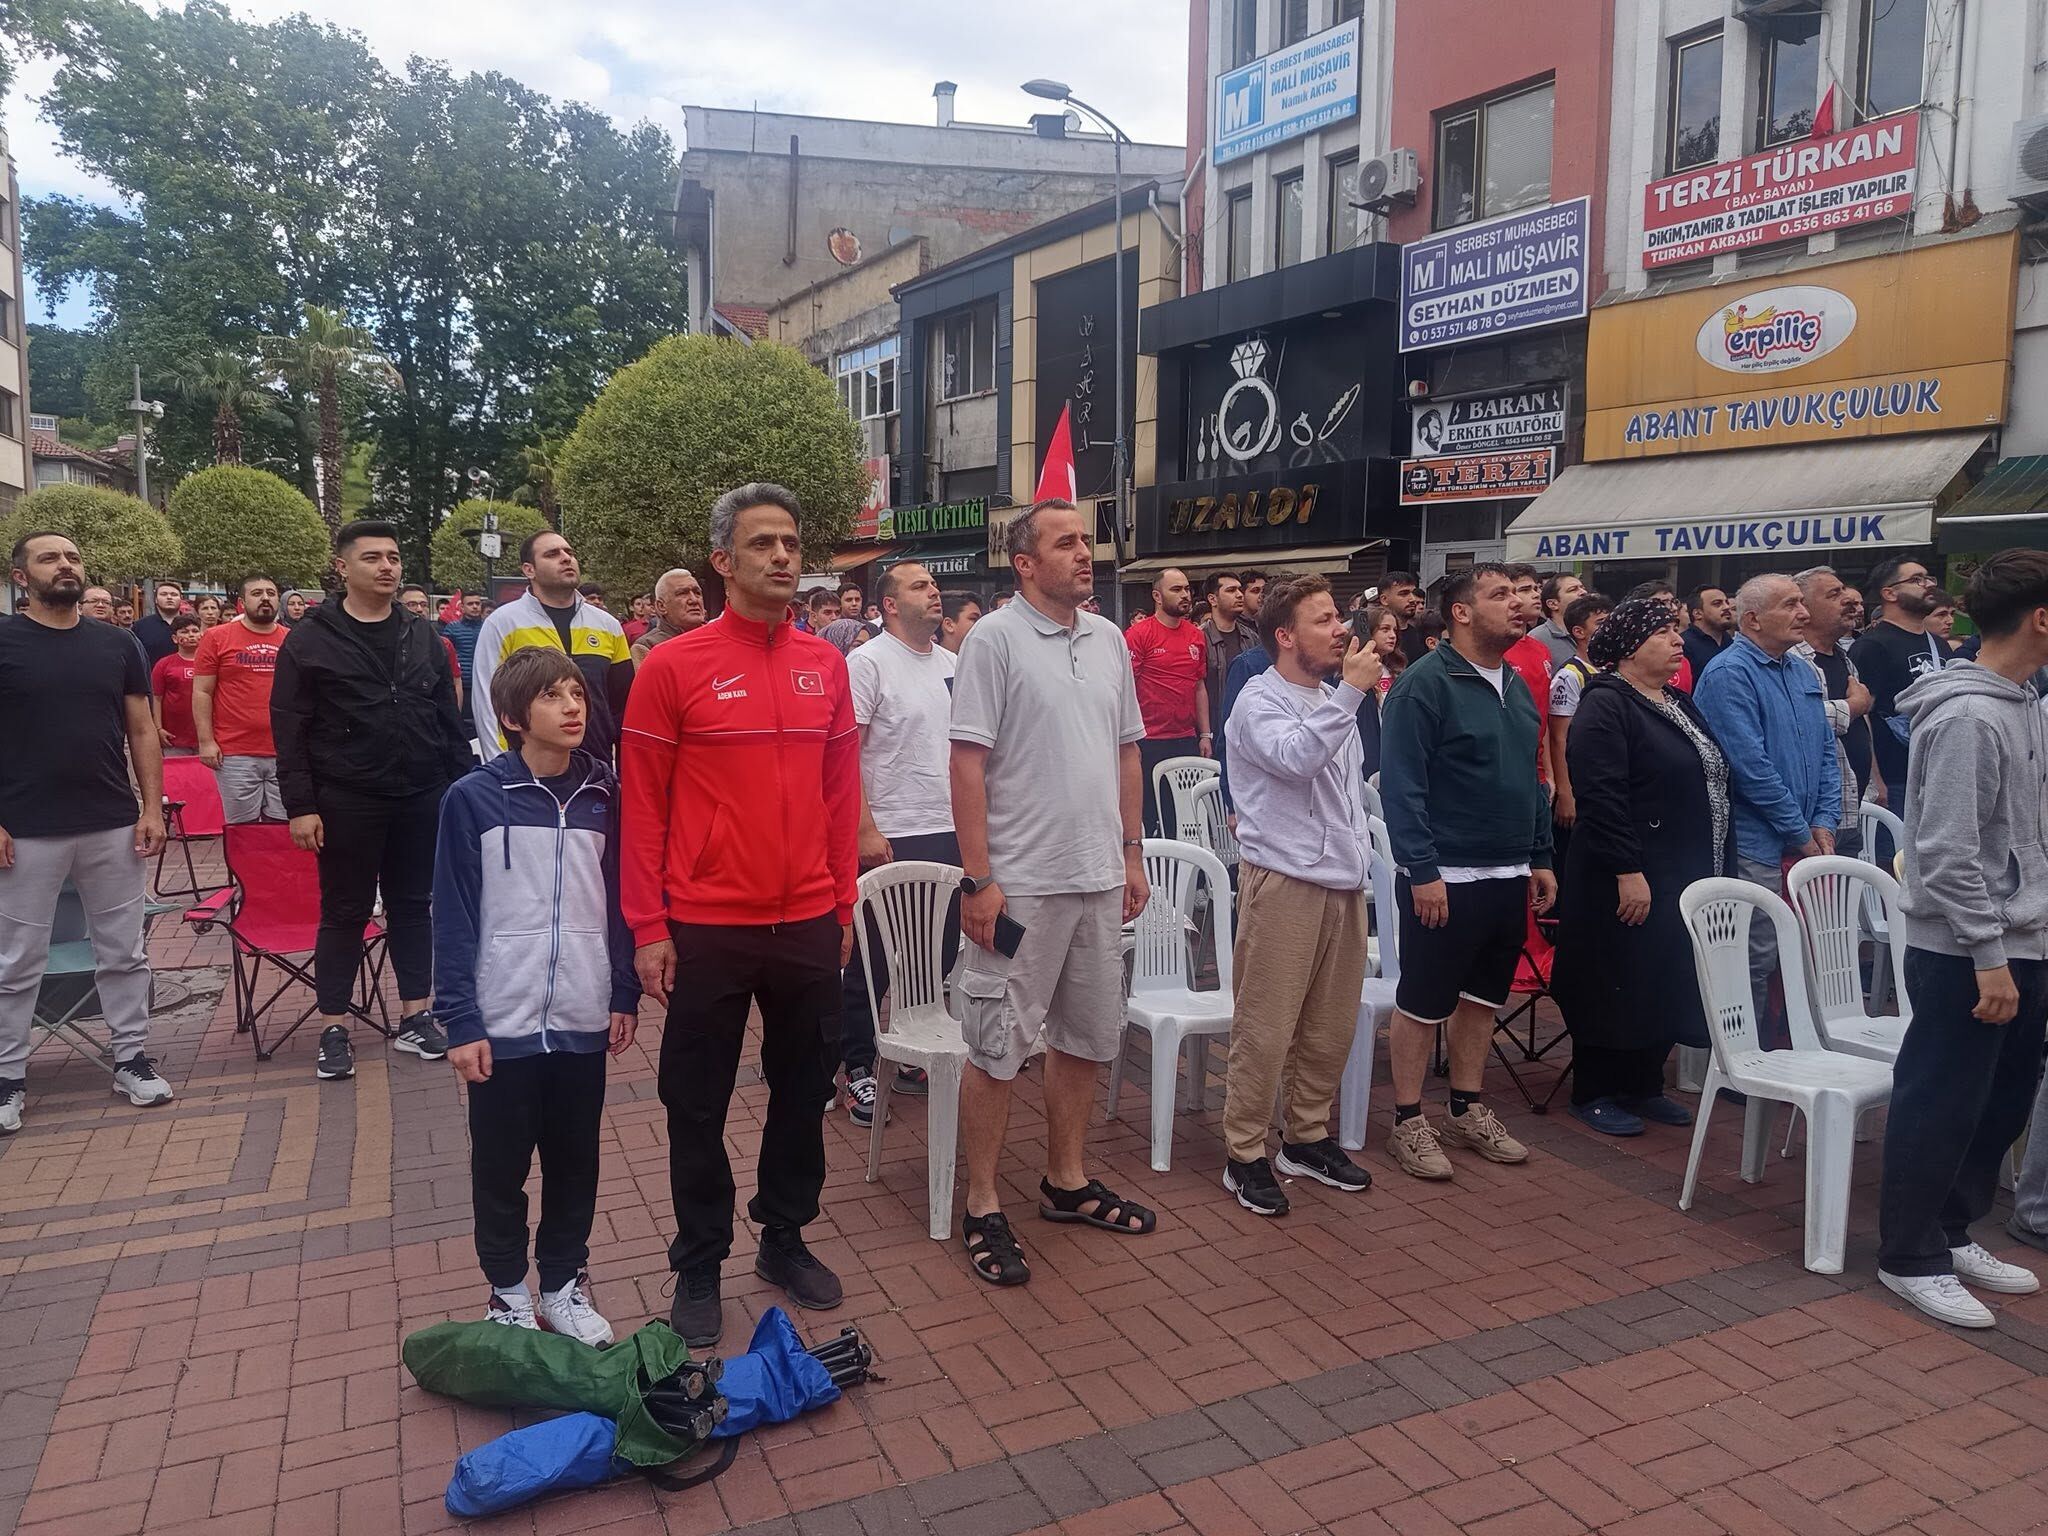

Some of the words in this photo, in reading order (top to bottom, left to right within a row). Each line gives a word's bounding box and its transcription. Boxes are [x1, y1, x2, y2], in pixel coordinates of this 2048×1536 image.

[1270, 54, 1302, 74] SERBEST
[1271, 69, 1297, 96] MALİ
[1300, 51, 1350, 86] MÜŞAVİR
[1751, 124, 1902, 188] TÜRKAN
[1848, 174, 1907, 202] YAPILIR
[1455, 230, 1502, 254] SERBEST
[1708, 228, 1763, 251] AKBAŞLI
[1780, 216, 1818, 235] 0.536
[1822, 210, 1850, 226] 863
[1854, 205, 1870, 218] 41
[1874, 200, 1894, 215] 66
[1450, 252, 1492, 286] MALİ
[1496, 232, 1579, 275] MÜŞAVİR
[1414, 292, 1485, 323] SEYHAN
[1491, 273, 1572, 306] DÜZMEN
[1422, 329, 1428, 340] 0
[1430, 326, 1446, 340] 537
[1449, 322, 1464, 336] 571
[1466, 319, 1478, 332] 48
[1480, 316, 1492, 328] 78
[1730, 316, 1816, 352] erpiliç
[1469, 392, 1546, 420] BARAN
[1625, 406, 1718, 444] ABANT
[1727, 379, 1942, 430] TAVUKÇULUK
[1449, 423, 1492, 442] ERKEK
[1496, 412, 1562, 435] KUAFÖRÜ
[1434, 454, 1548, 486] TERZİ
[896, 505, 929, 534] YEŞİL
[932, 497, 984, 533] ÇİFTLİĞİ
[1536, 531, 1630, 558] ABANT
[1656, 514, 1886, 551] TAVUKÇULUK
